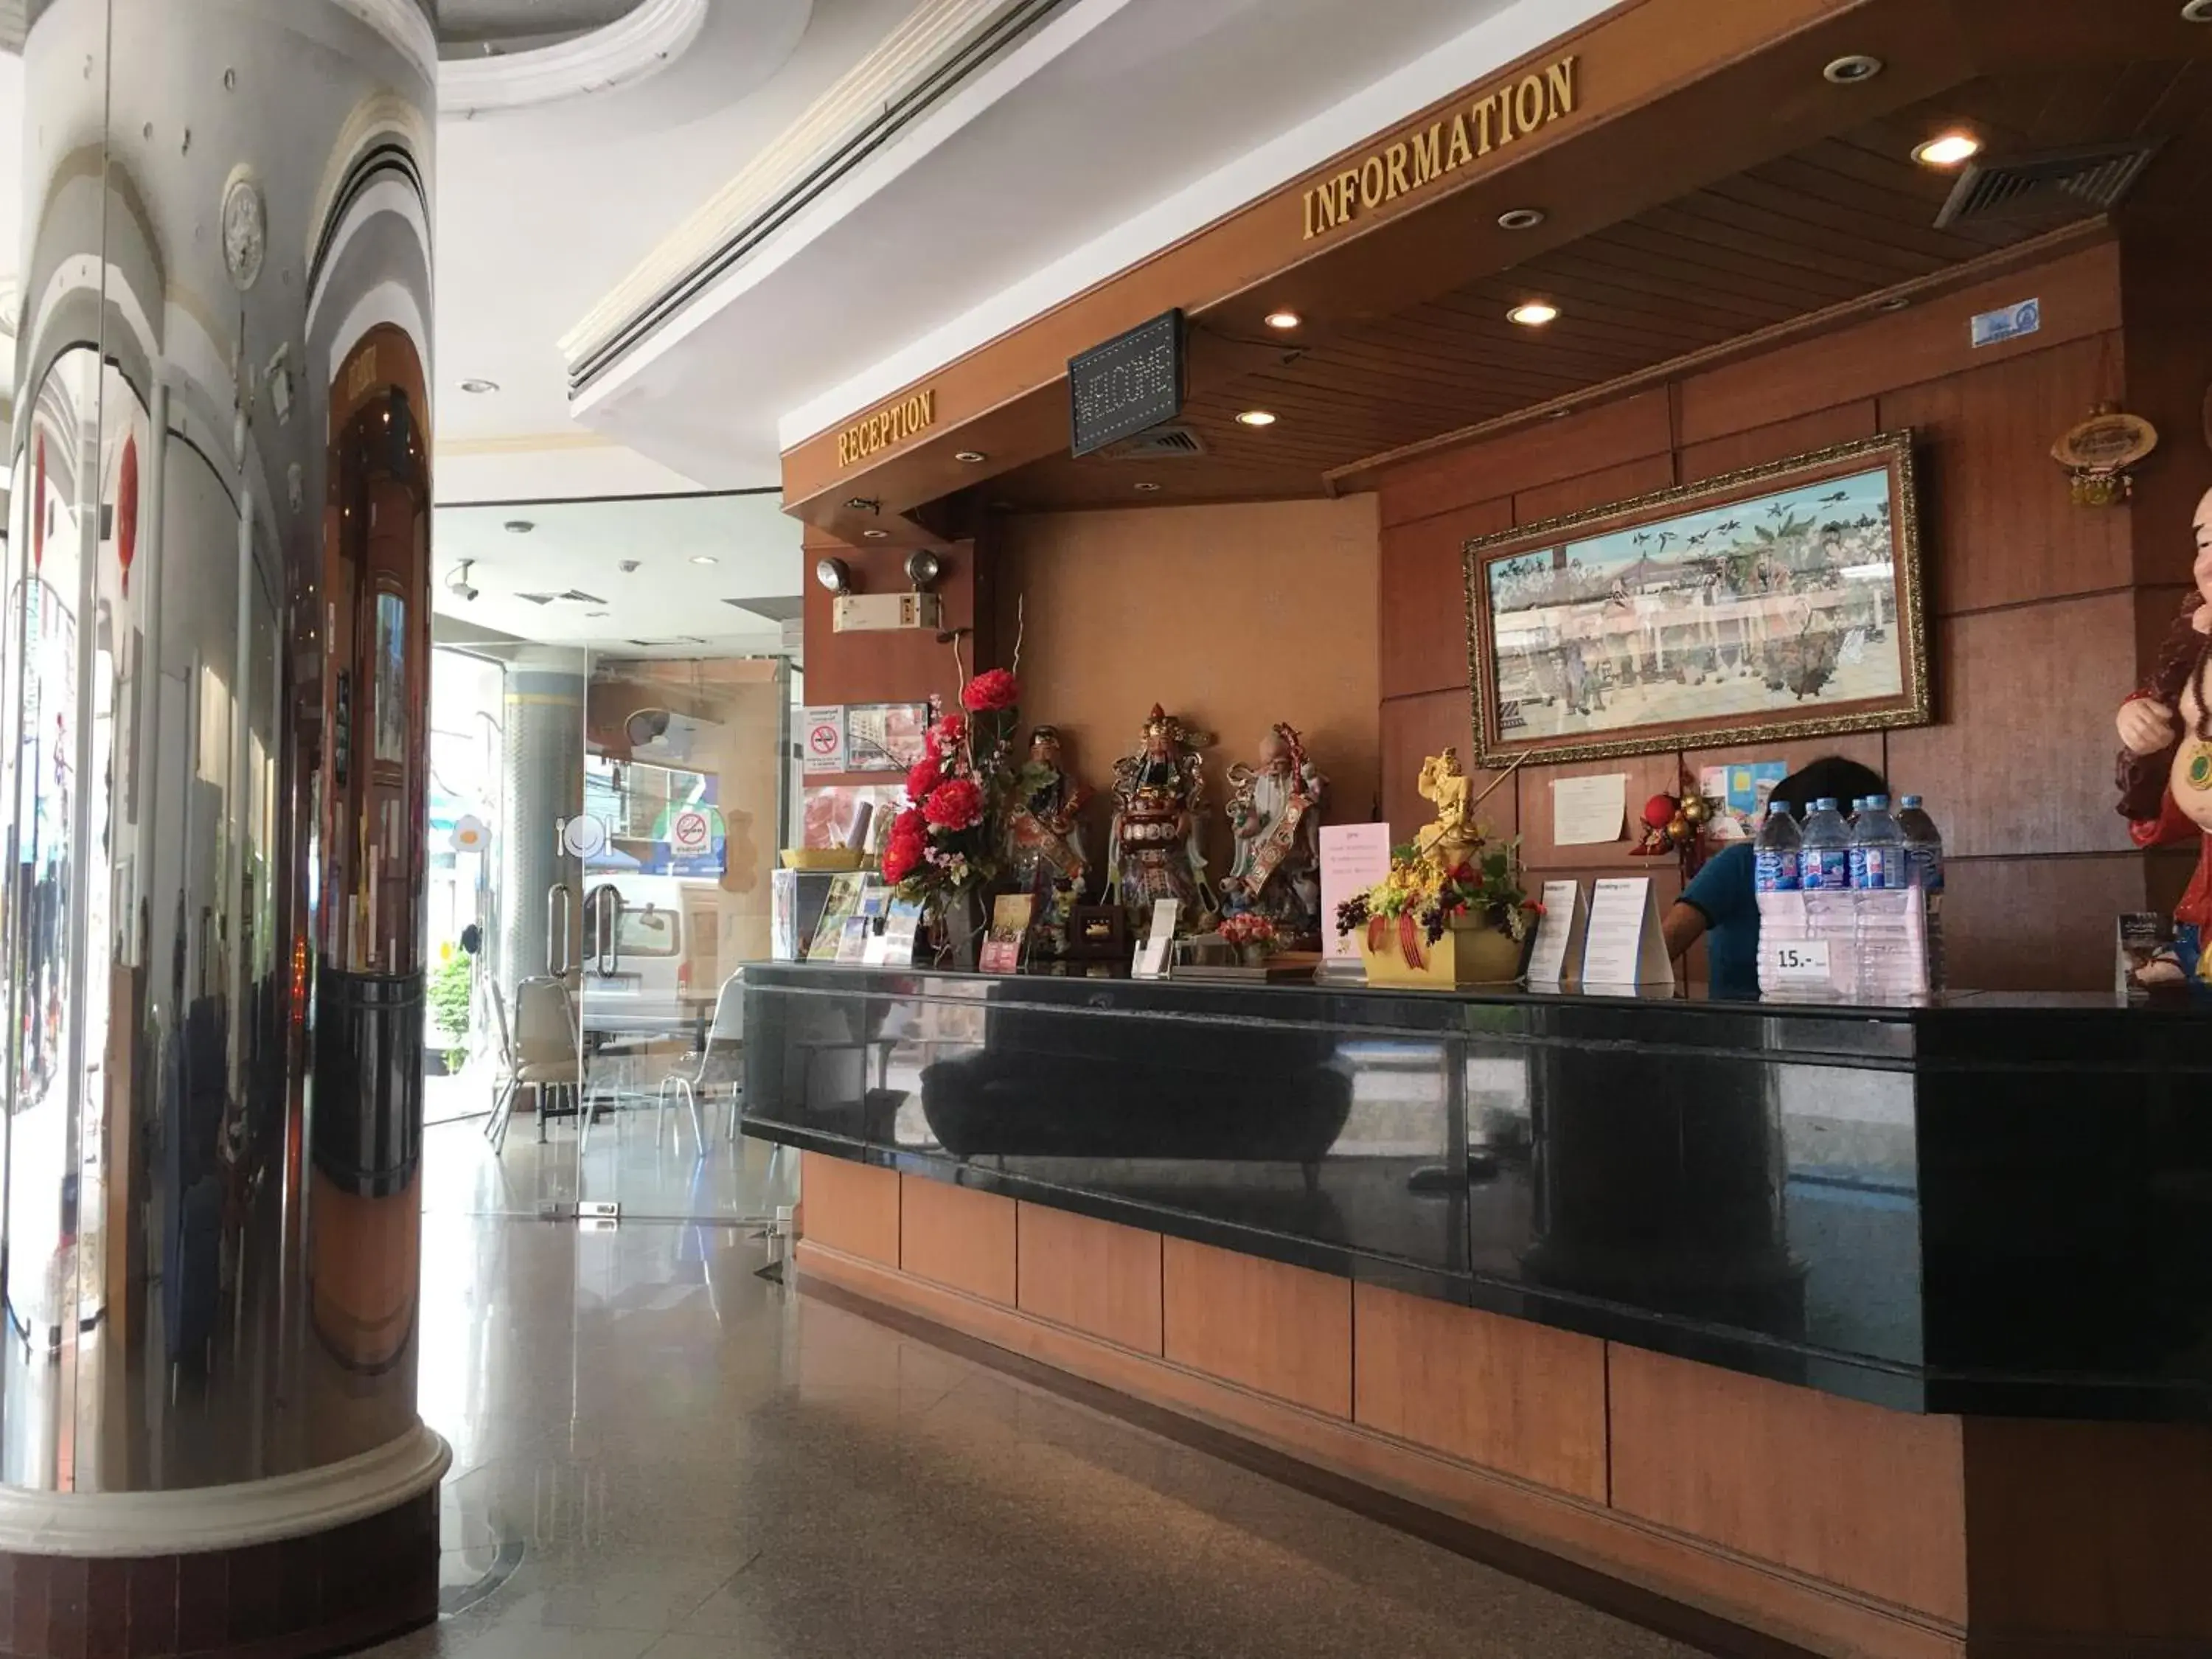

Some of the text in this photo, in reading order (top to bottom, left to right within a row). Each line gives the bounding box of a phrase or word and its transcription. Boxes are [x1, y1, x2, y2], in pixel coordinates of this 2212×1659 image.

[1302, 55, 1574, 240] INFORMATION
[1077, 345, 1166, 423] WELCOME
[838, 390, 931, 468] RECEPTION
[1778, 950, 1812, 967] 15.-
